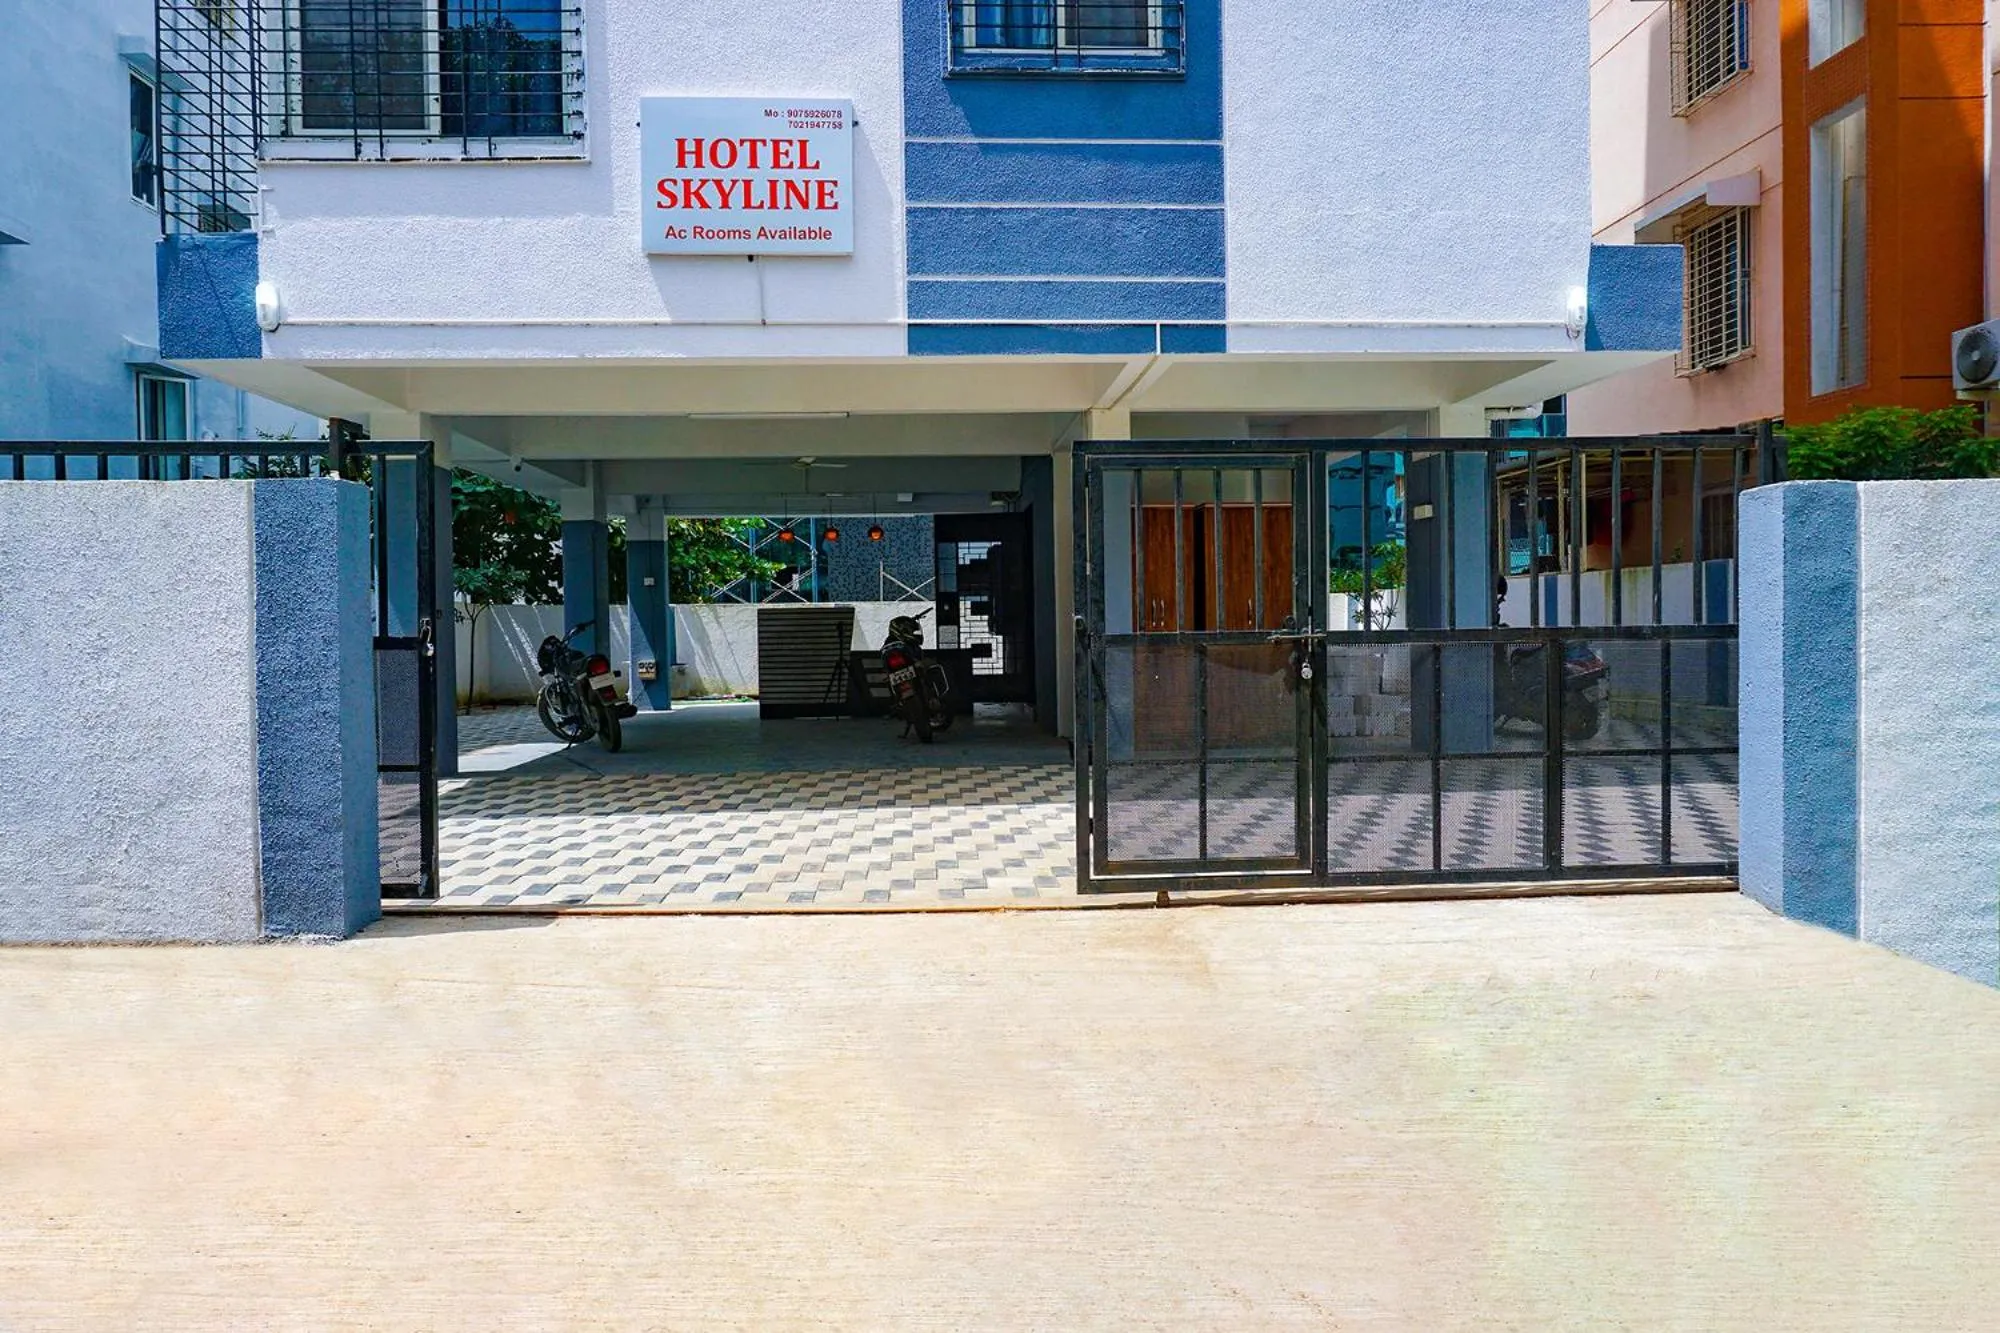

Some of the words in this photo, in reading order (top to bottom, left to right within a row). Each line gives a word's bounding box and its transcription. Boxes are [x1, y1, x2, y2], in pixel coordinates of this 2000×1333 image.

[764, 109, 779, 118] Mo
[786, 108, 842, 119] 9075926078
[675, 138, 821, 170] HOTEL
[656, 178, 839, 210] SKYLINE
[664, 225, 687, 240] Ac
[692, 226, 751, 241] Rooms
[756, 226, 833, 241] Available
